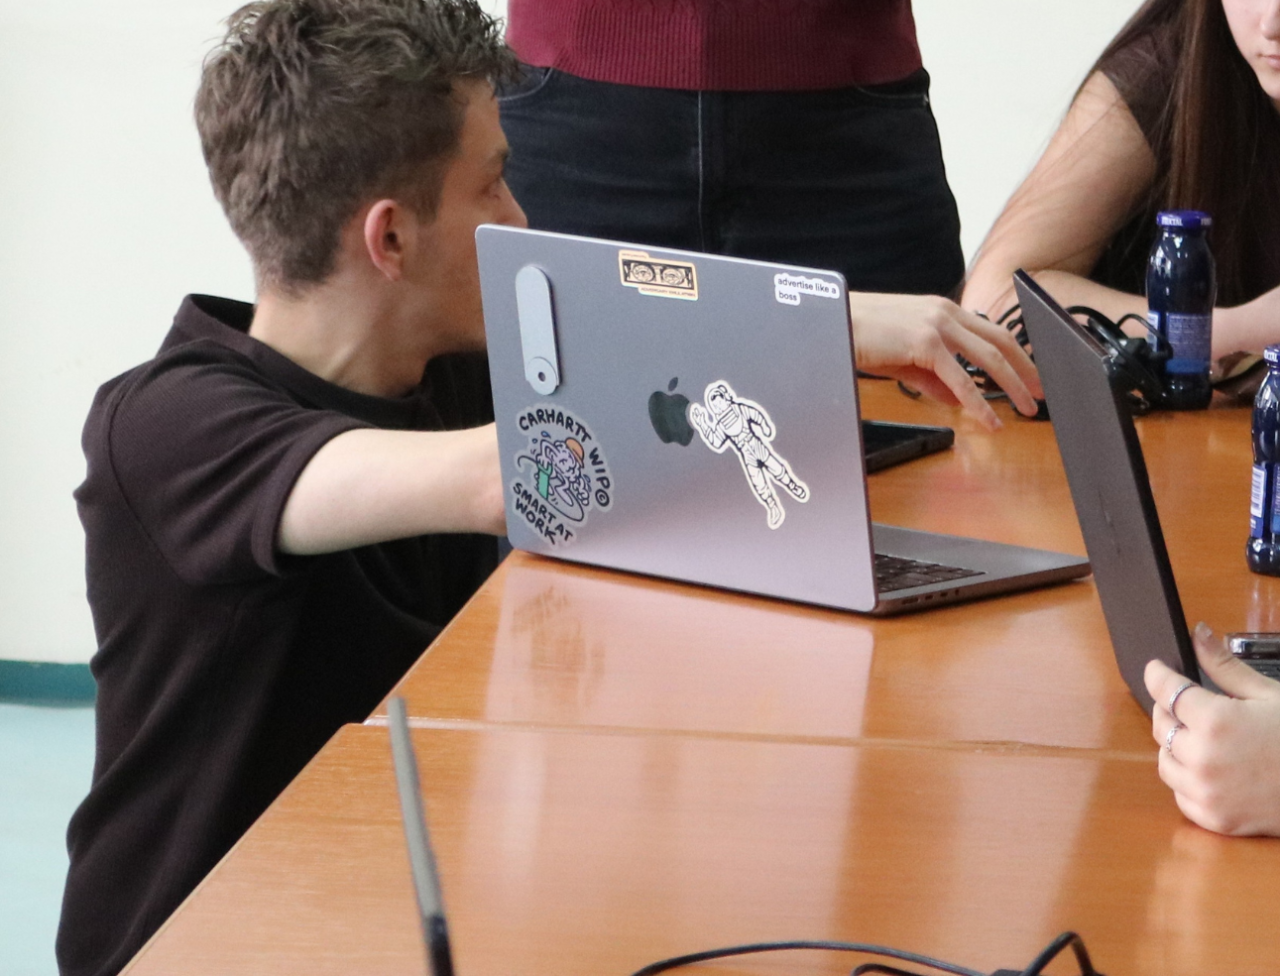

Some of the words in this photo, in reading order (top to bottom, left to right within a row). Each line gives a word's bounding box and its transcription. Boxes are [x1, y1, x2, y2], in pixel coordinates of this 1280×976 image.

[778, 277, 814, 290] advertise
[815, 282, 830, 293] like
[779, 290, 797, 301] boss
[519, 408, 592, 442] CARHARTT
[513, 482, 557, 524] SMART
[554, 523, 574, 541] AT
[515, 498, 557, 545] WORK
